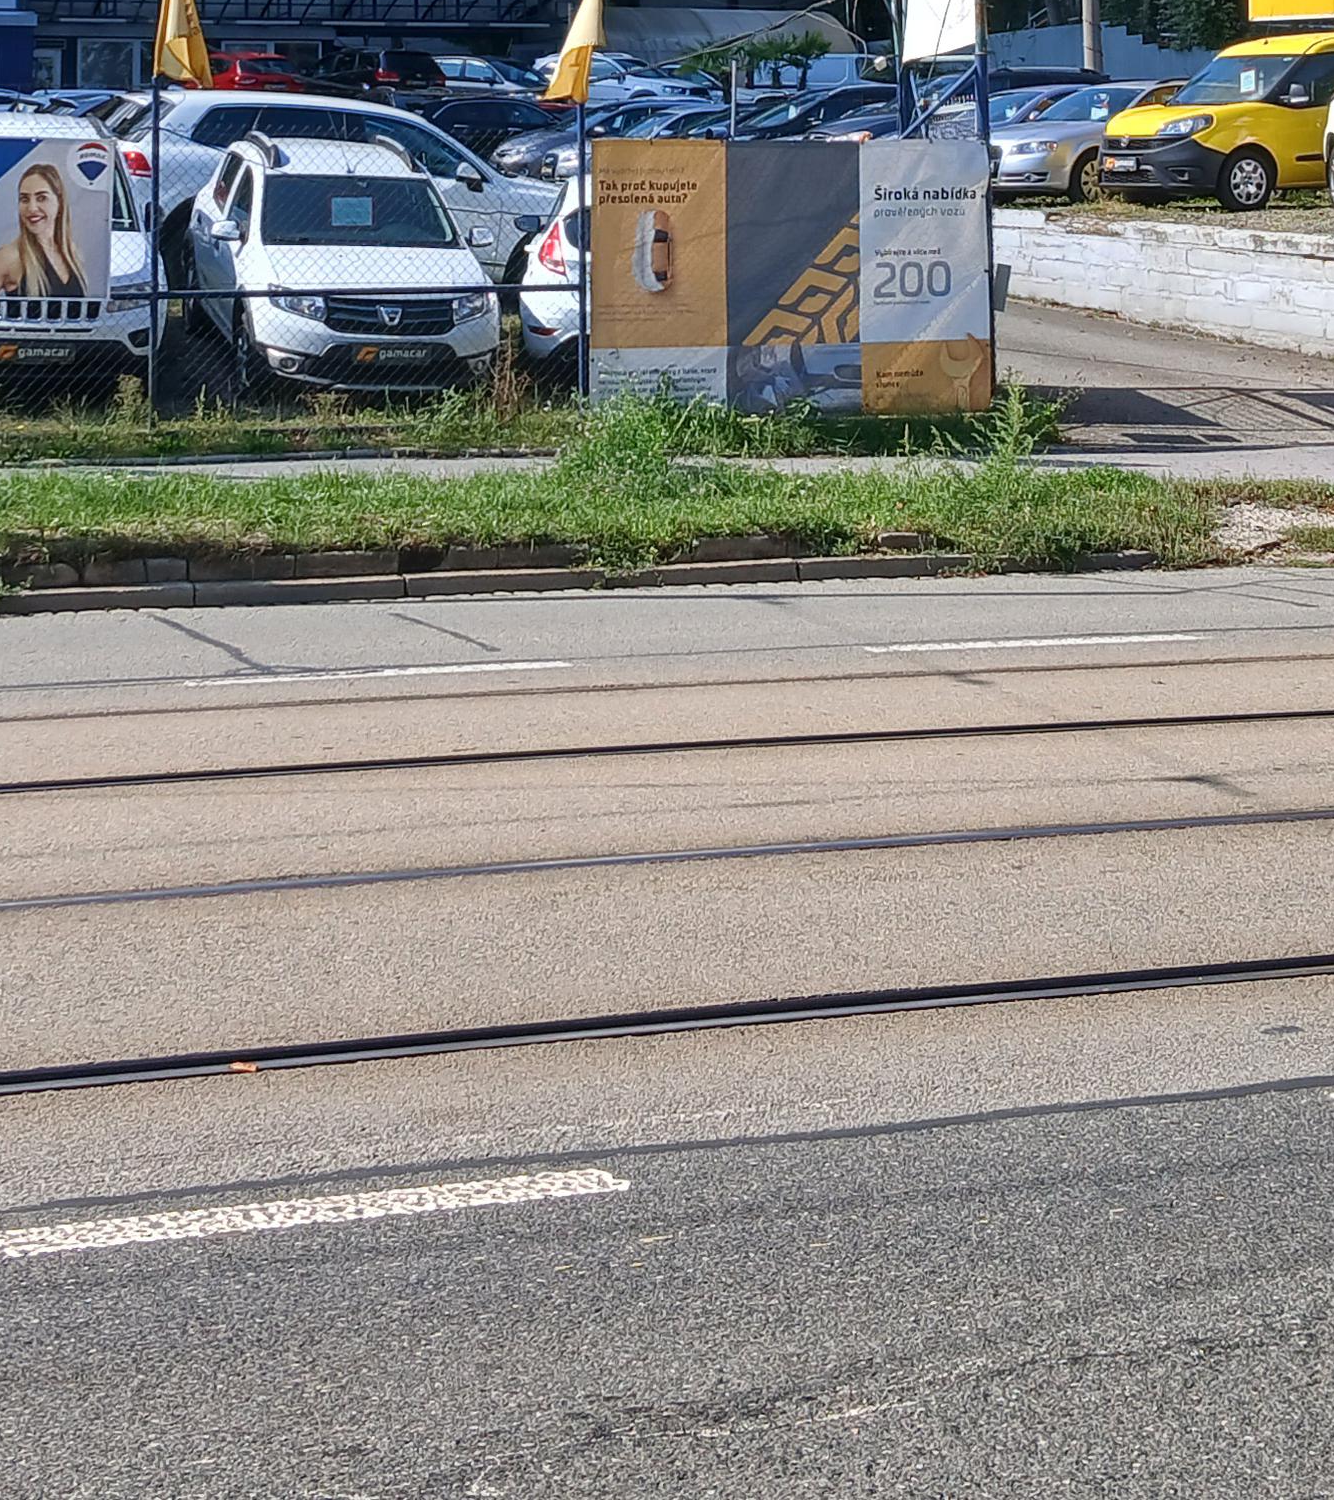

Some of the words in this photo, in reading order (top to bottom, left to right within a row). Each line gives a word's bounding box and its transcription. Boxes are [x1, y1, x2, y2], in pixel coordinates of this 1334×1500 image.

[599, 180, 618, 191] Tak
[649, 180, 698, 192] kupujete
[874, 185, 919, 201] Široká
[923, 187, 976, 200] nabídka
[599, 194, 654, 206] přesolená
[657, 193, 688, 204] auta?
[873, 260, 951, 298] 200
[18, 348, 70, 359] gamacar
[379, 349, 427, 360] gamacar
